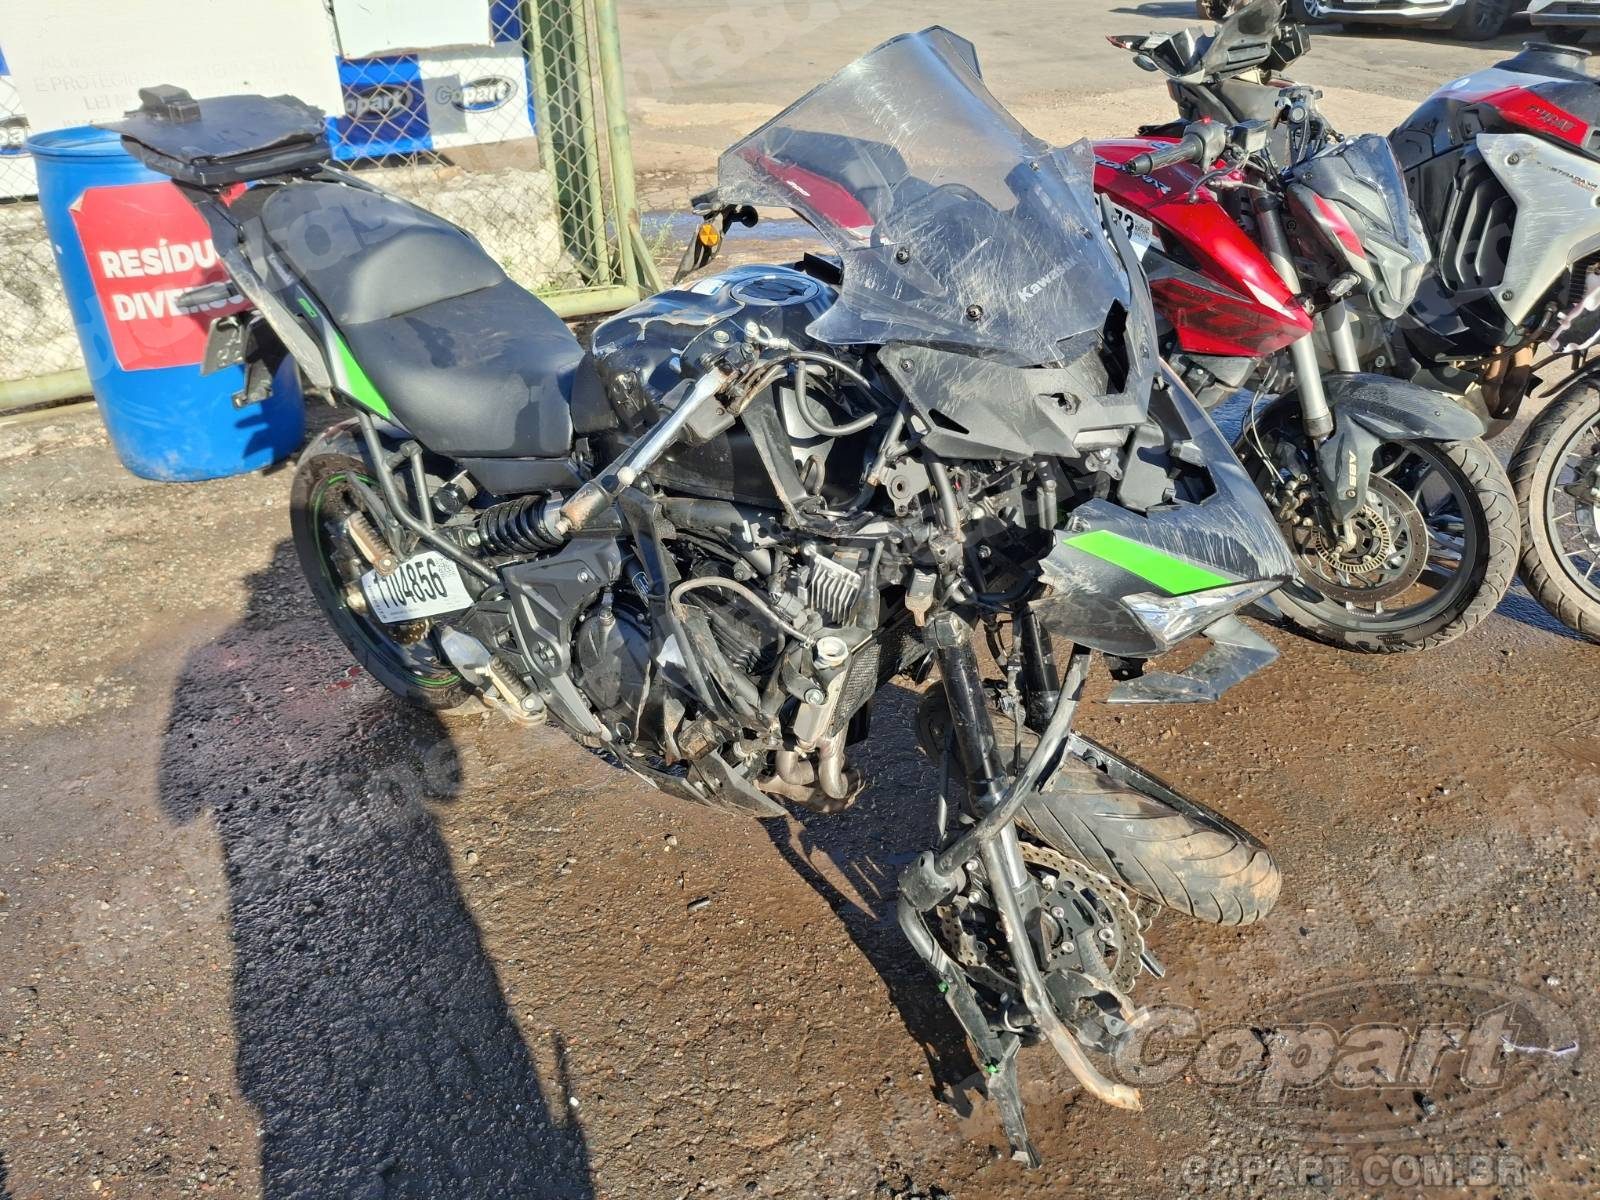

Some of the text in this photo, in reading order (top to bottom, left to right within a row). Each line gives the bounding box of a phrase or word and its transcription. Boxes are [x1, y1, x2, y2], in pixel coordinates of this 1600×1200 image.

[344, 90, 400, 118] opart
[435, 81, 509, 110] Copart
[99, 238, 219, 278] RESÍDU
